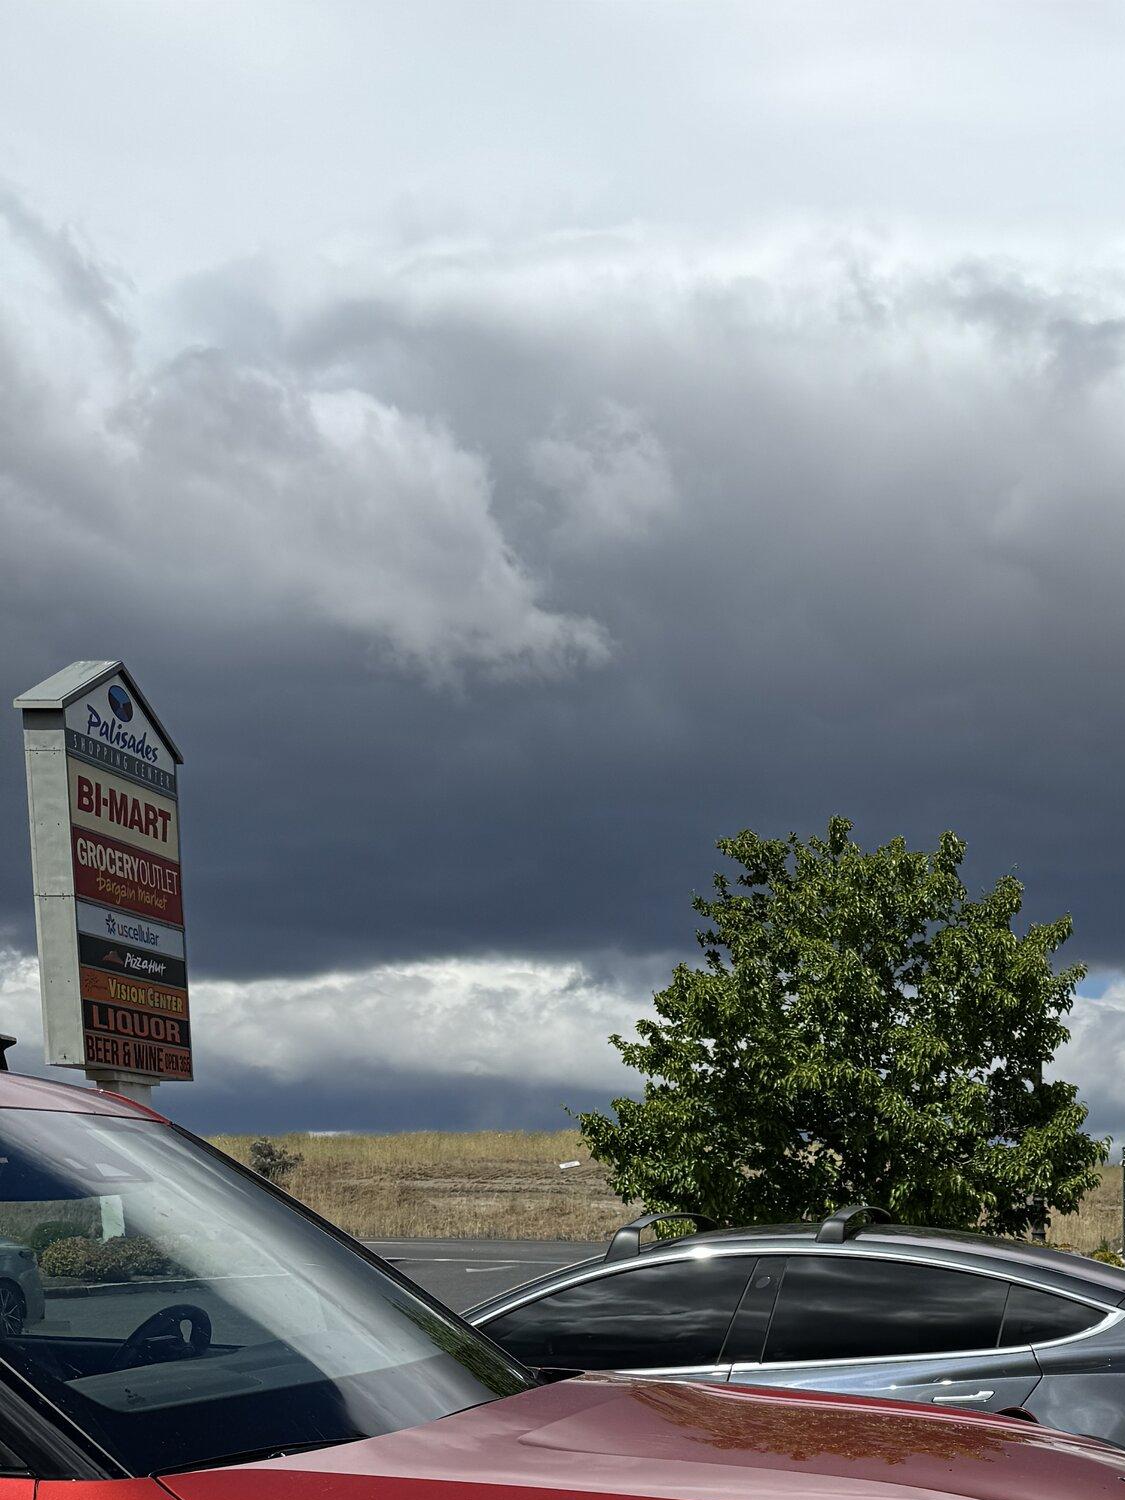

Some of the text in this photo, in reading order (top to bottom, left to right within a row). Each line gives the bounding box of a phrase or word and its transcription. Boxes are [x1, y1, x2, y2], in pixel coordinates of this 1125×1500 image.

[73, 733, 171, 789] SHOPPING CENTER
[86, 703, 159, 764] Palisades
[77, 774, 172, 843] BI-MART
[91, 1004, 181, 1043] LIQUOR
[86, 1035, 120, 1067] BEER
[122, 1041, 131, 1068] &
[133, 1041, 164, 1073] WINE
[164, 1052, 179, 1071] OPEN
